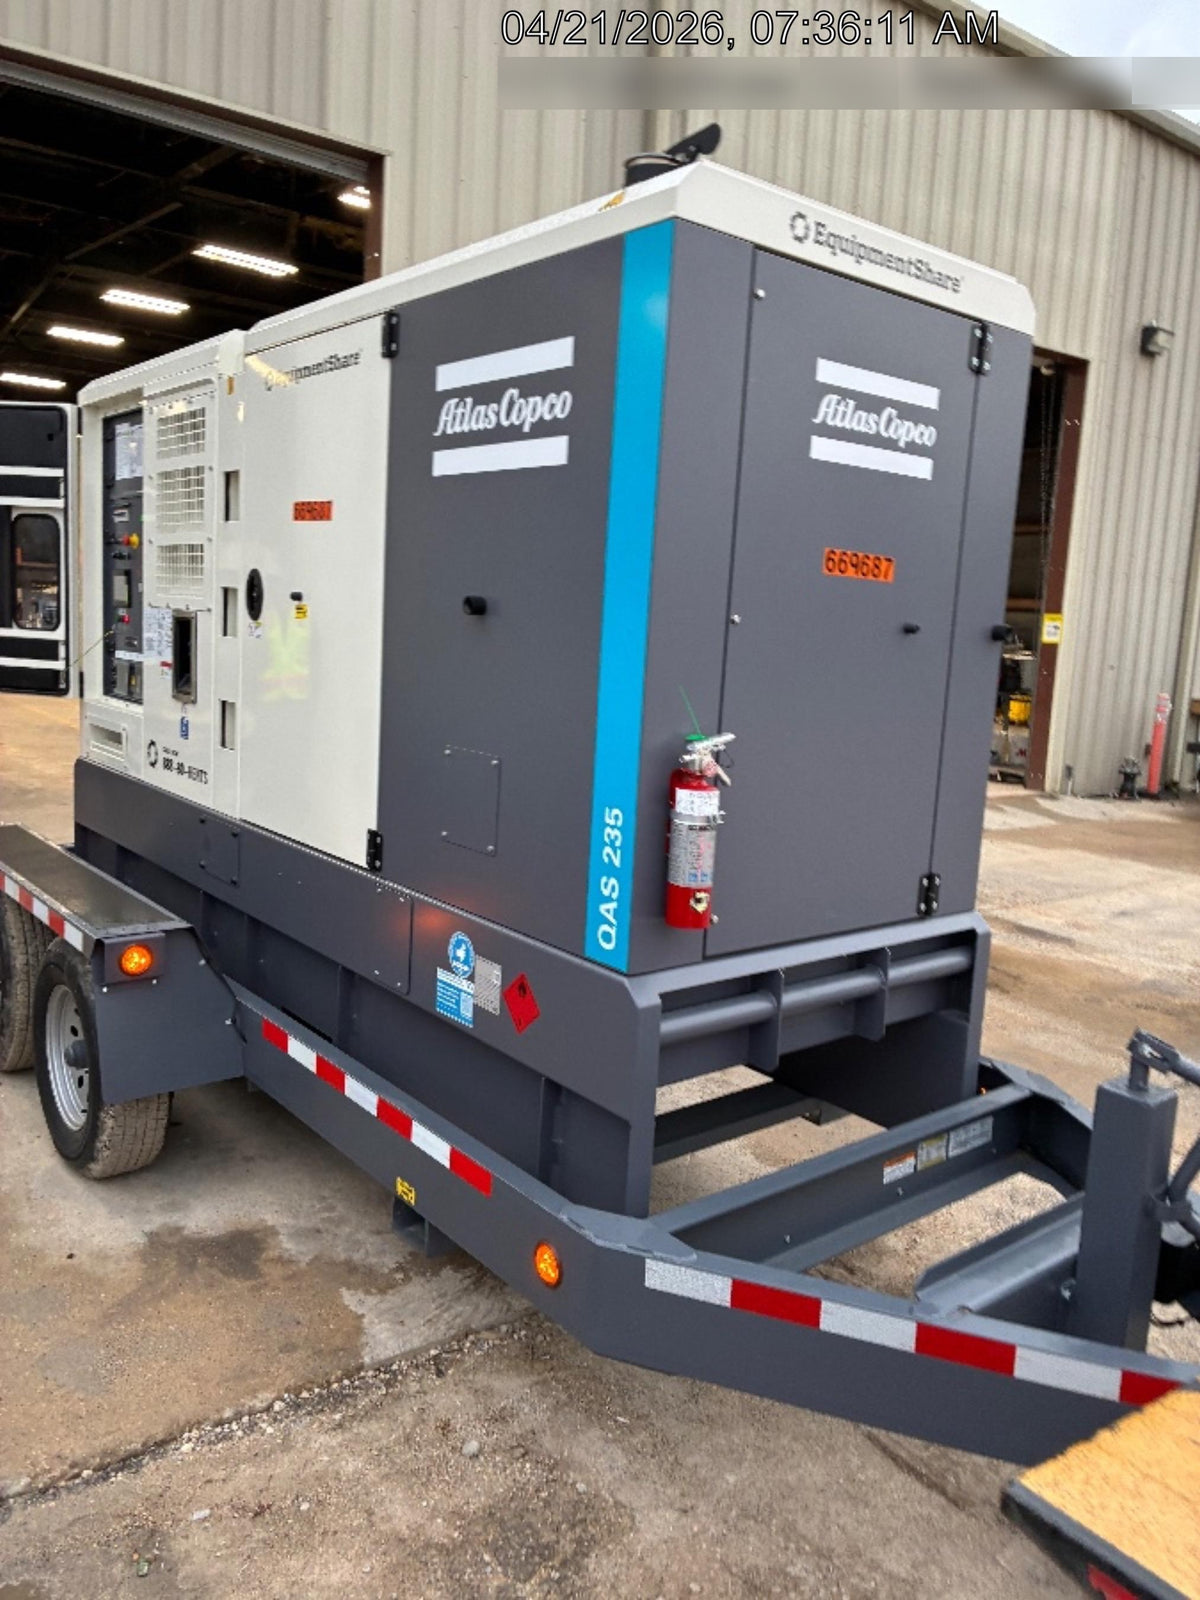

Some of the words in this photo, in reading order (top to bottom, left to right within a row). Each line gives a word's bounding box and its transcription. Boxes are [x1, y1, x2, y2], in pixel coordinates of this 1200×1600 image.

[813, 220, 962, 293] EquipmentShare
[432, 396, 499, 436] Atlas
[499, 387, 573, 433] Copco
[812, 393, 879, 435] Atlas
[878, 406, 938, 448] Copco
[825, 549, 894, 579] 669687
[602, 806, 623, 868] 235
[597, 876, 620, 951] QAS
